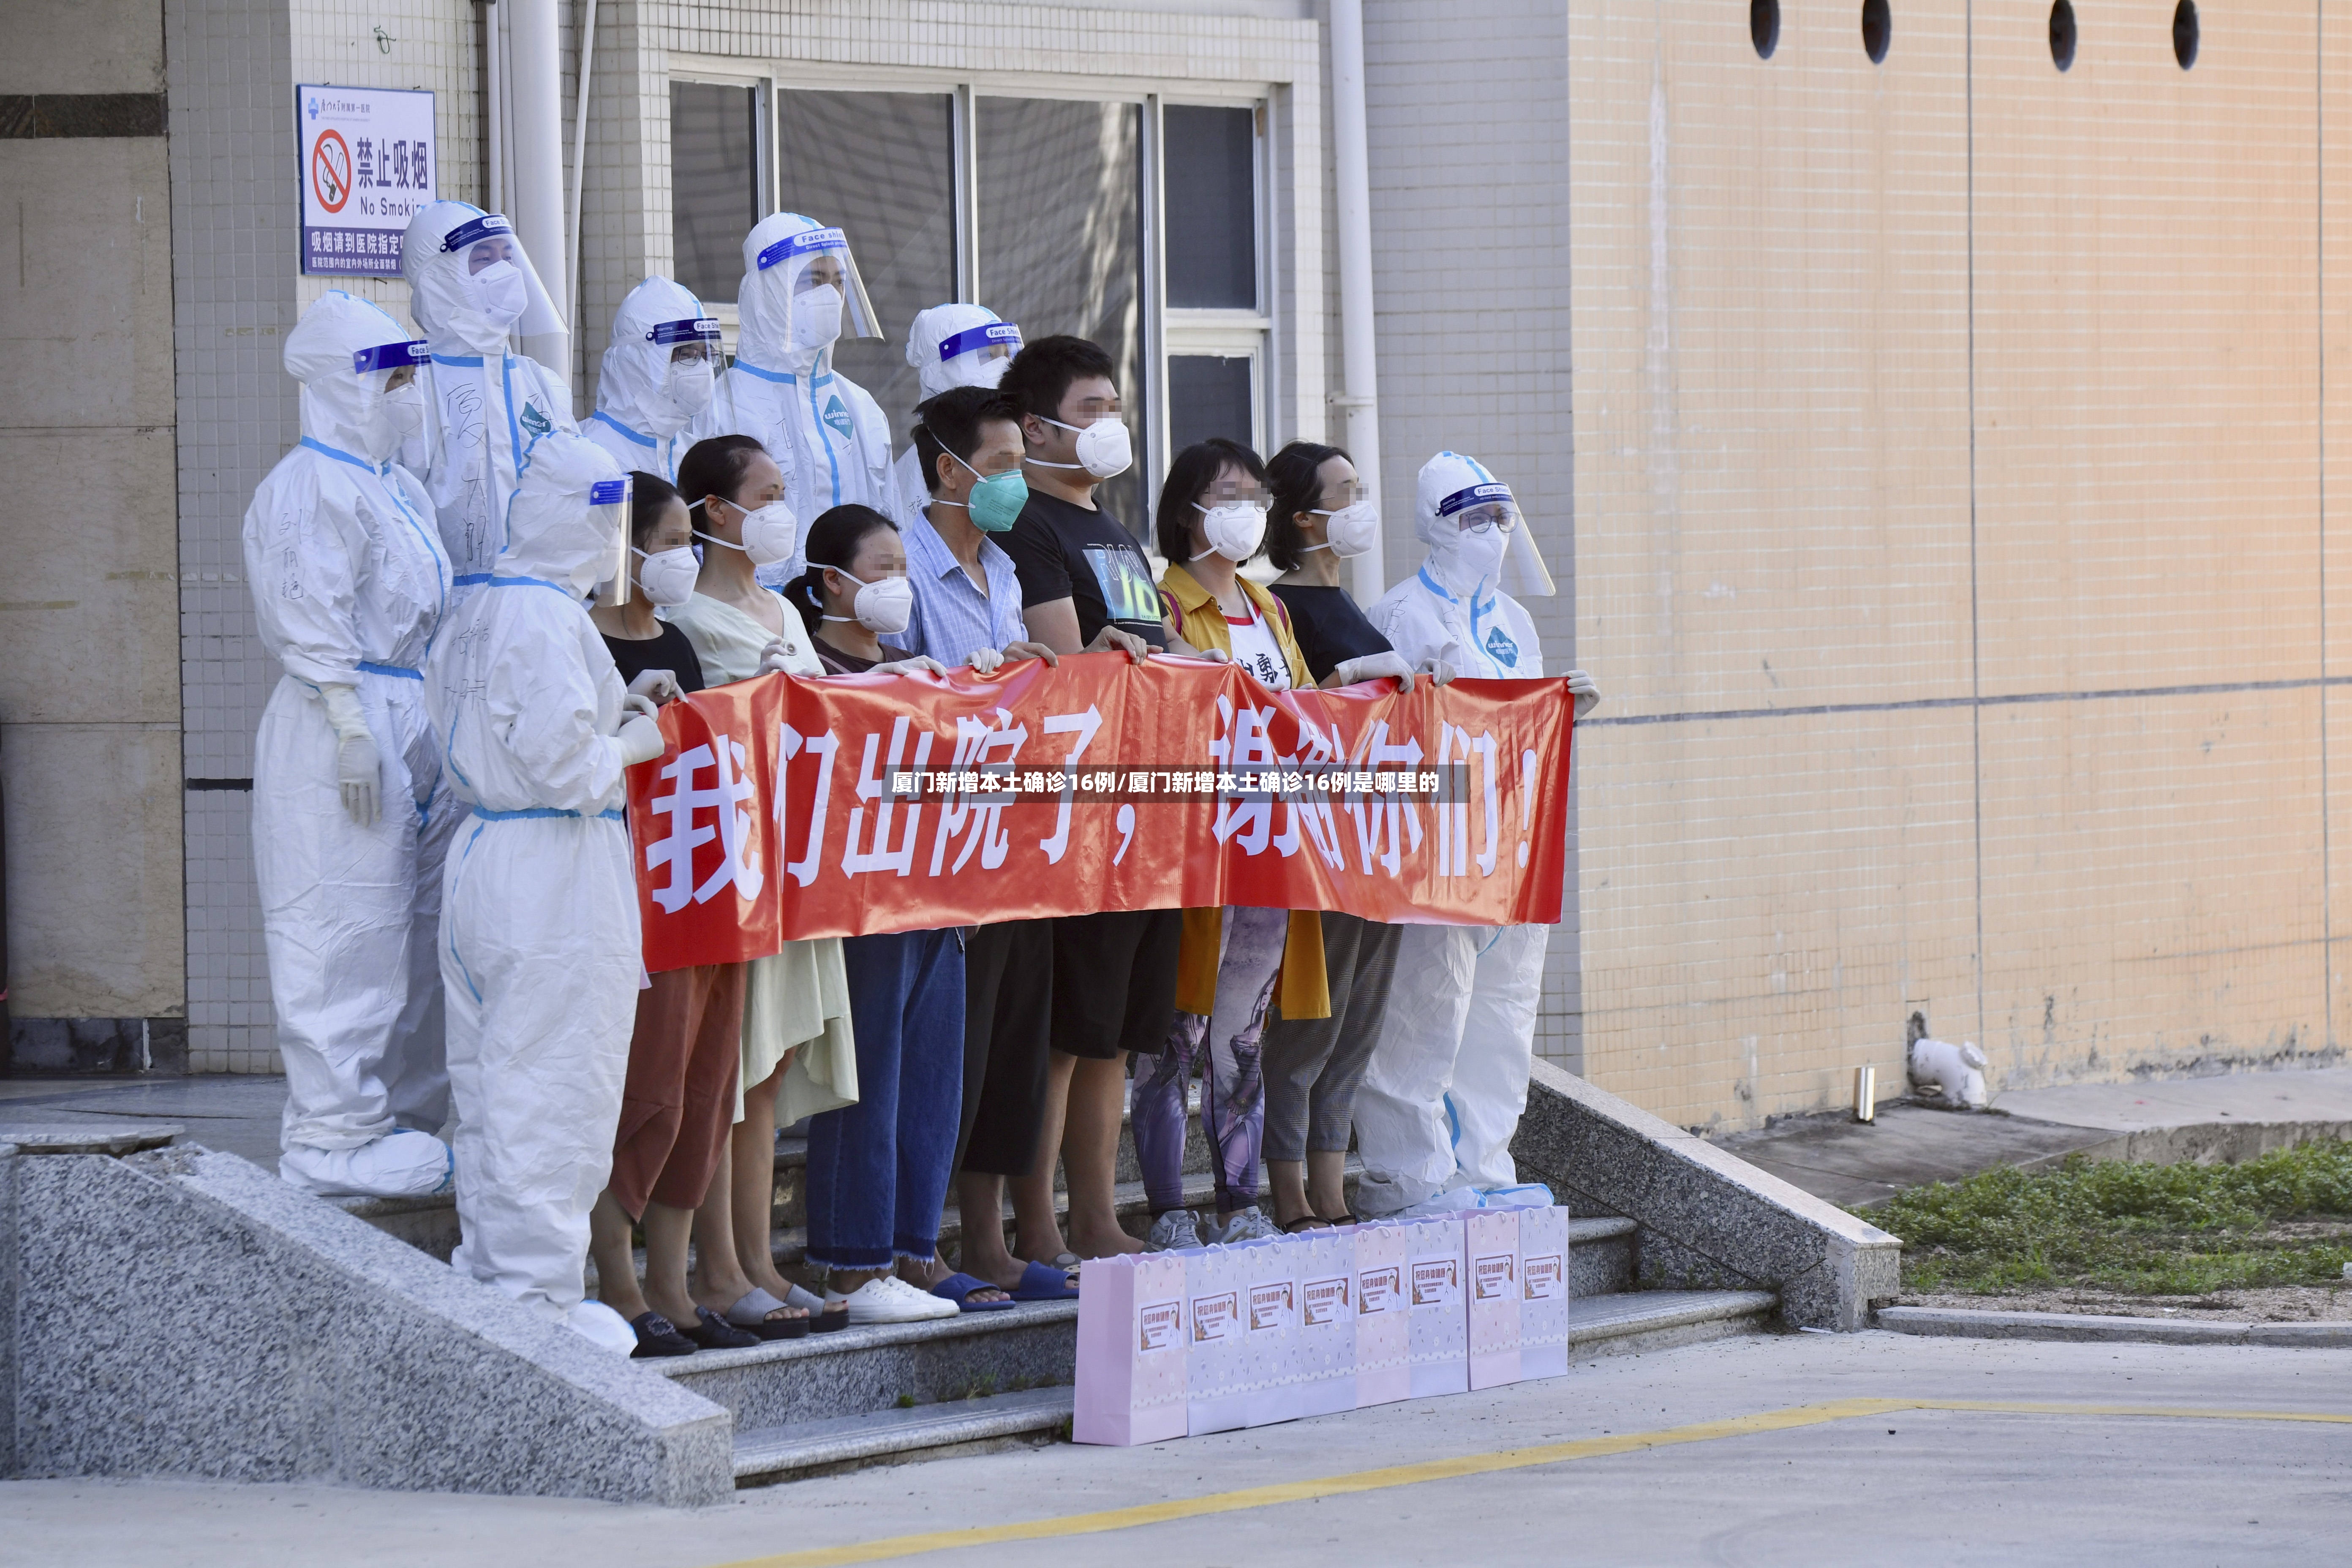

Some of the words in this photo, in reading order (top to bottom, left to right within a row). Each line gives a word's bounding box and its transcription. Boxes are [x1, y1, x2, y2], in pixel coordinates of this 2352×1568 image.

[357, 137, 427, 190] 禁止吸烟
[361, 196, 374, 215] No
[802, 234, 825, 242] Face
[1488, 640, 1513, 648] winner
